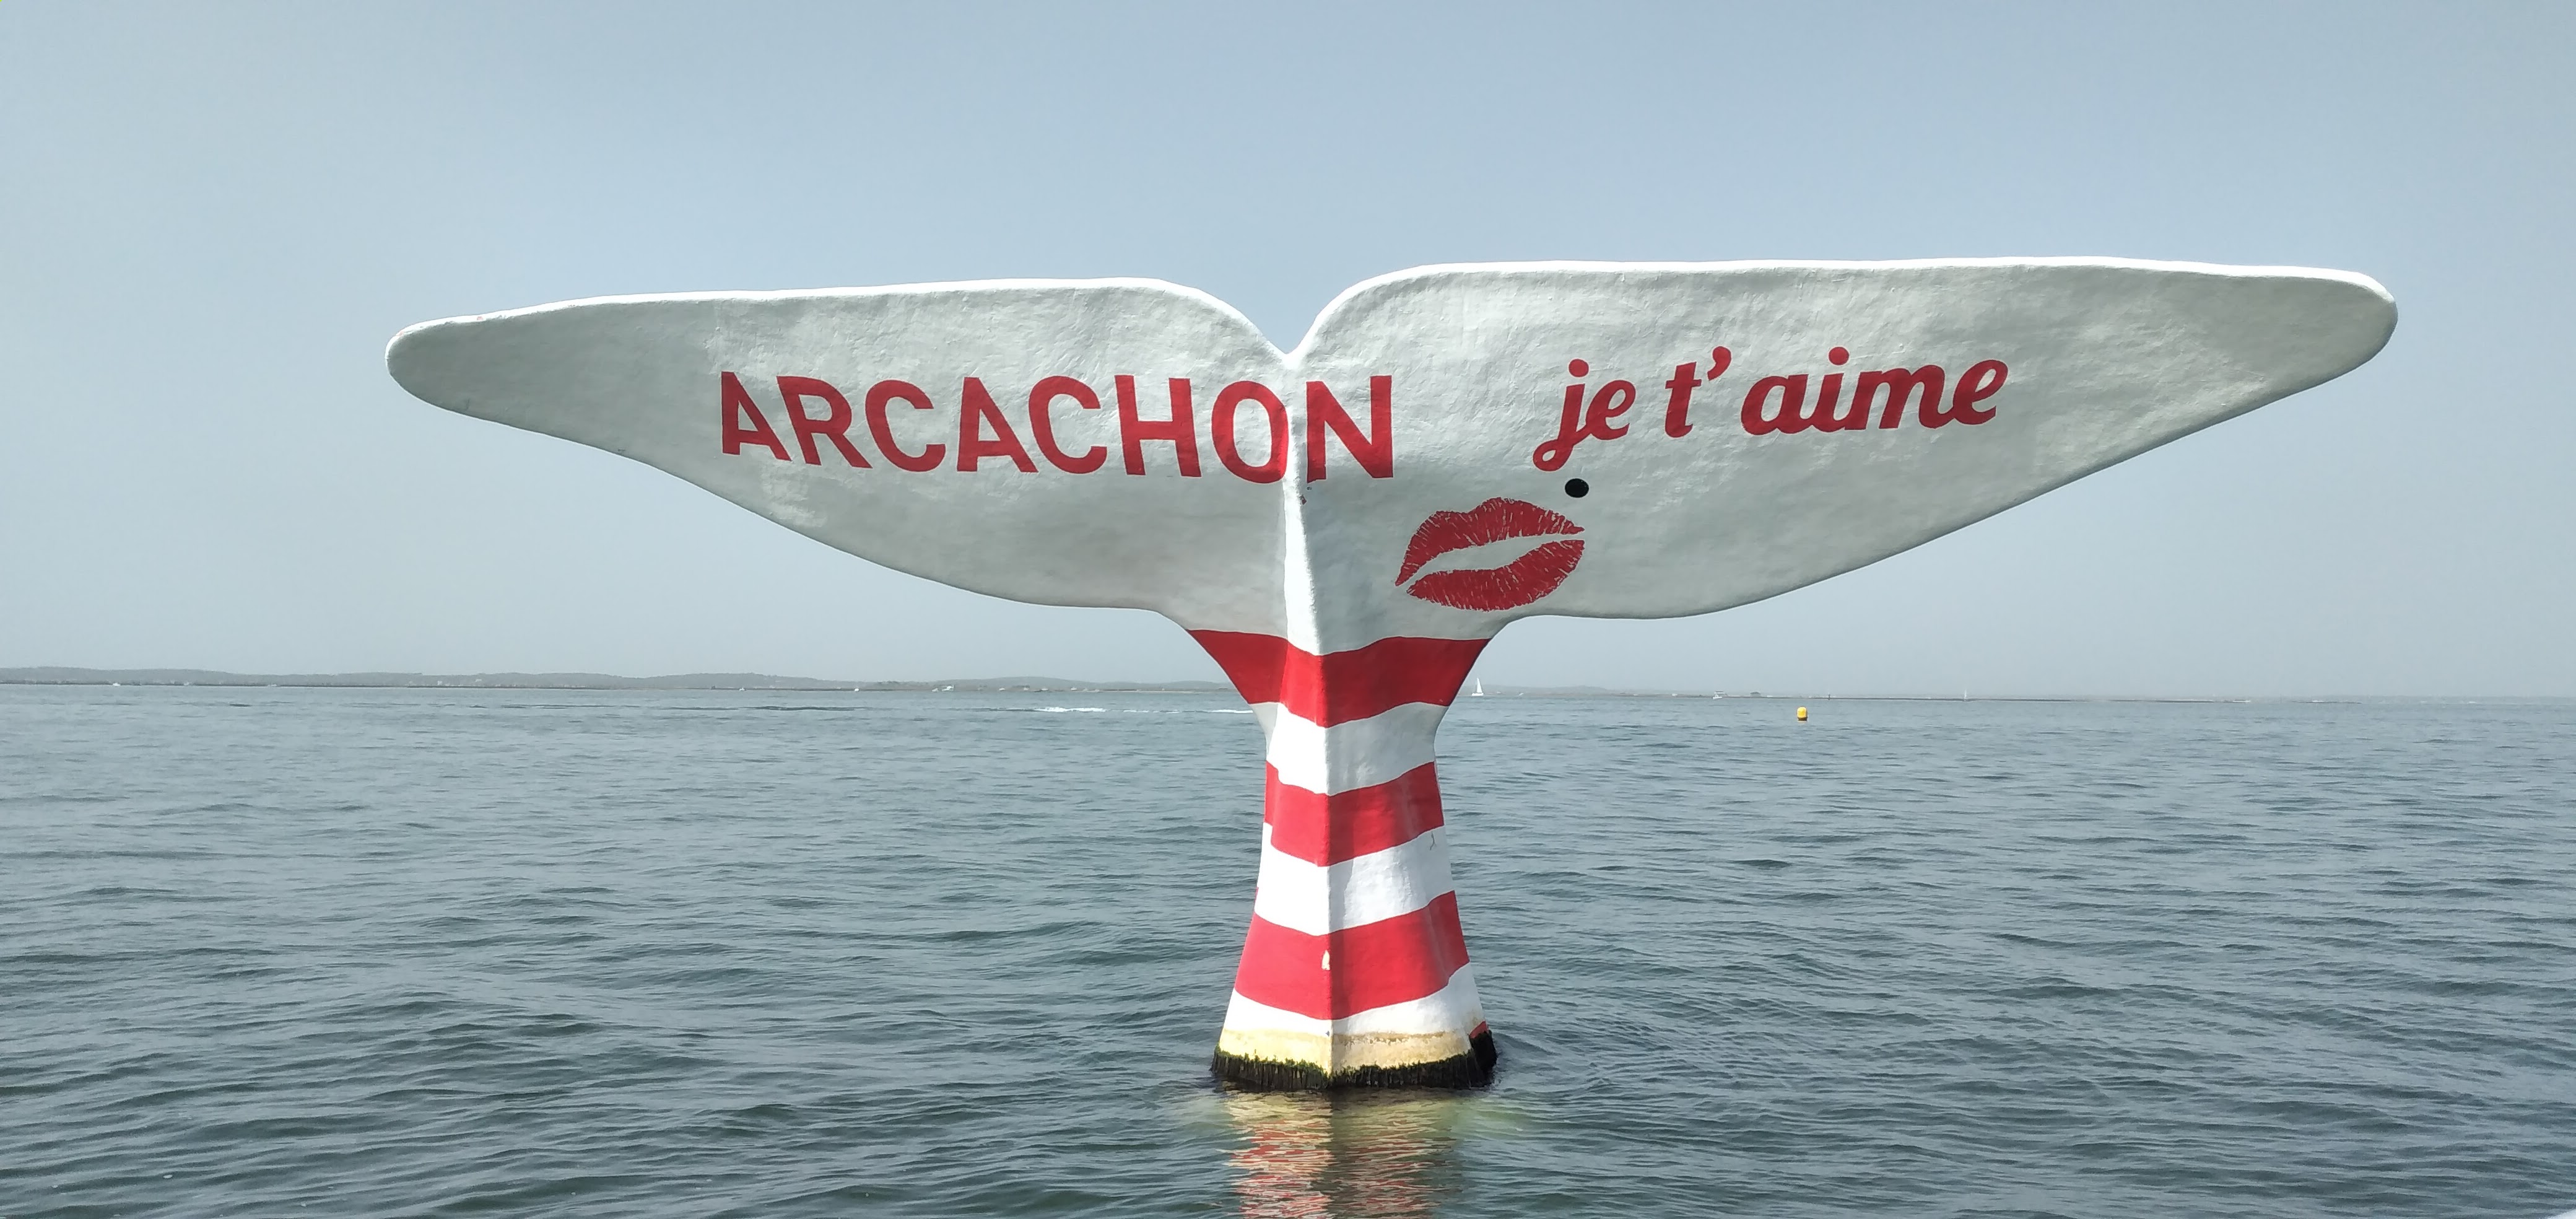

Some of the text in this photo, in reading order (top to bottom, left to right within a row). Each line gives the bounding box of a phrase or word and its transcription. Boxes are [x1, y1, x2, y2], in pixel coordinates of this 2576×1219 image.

[721, 371, 1394, 484] ARCACHON
[1533, 346, 2008, 472] je t'aime
